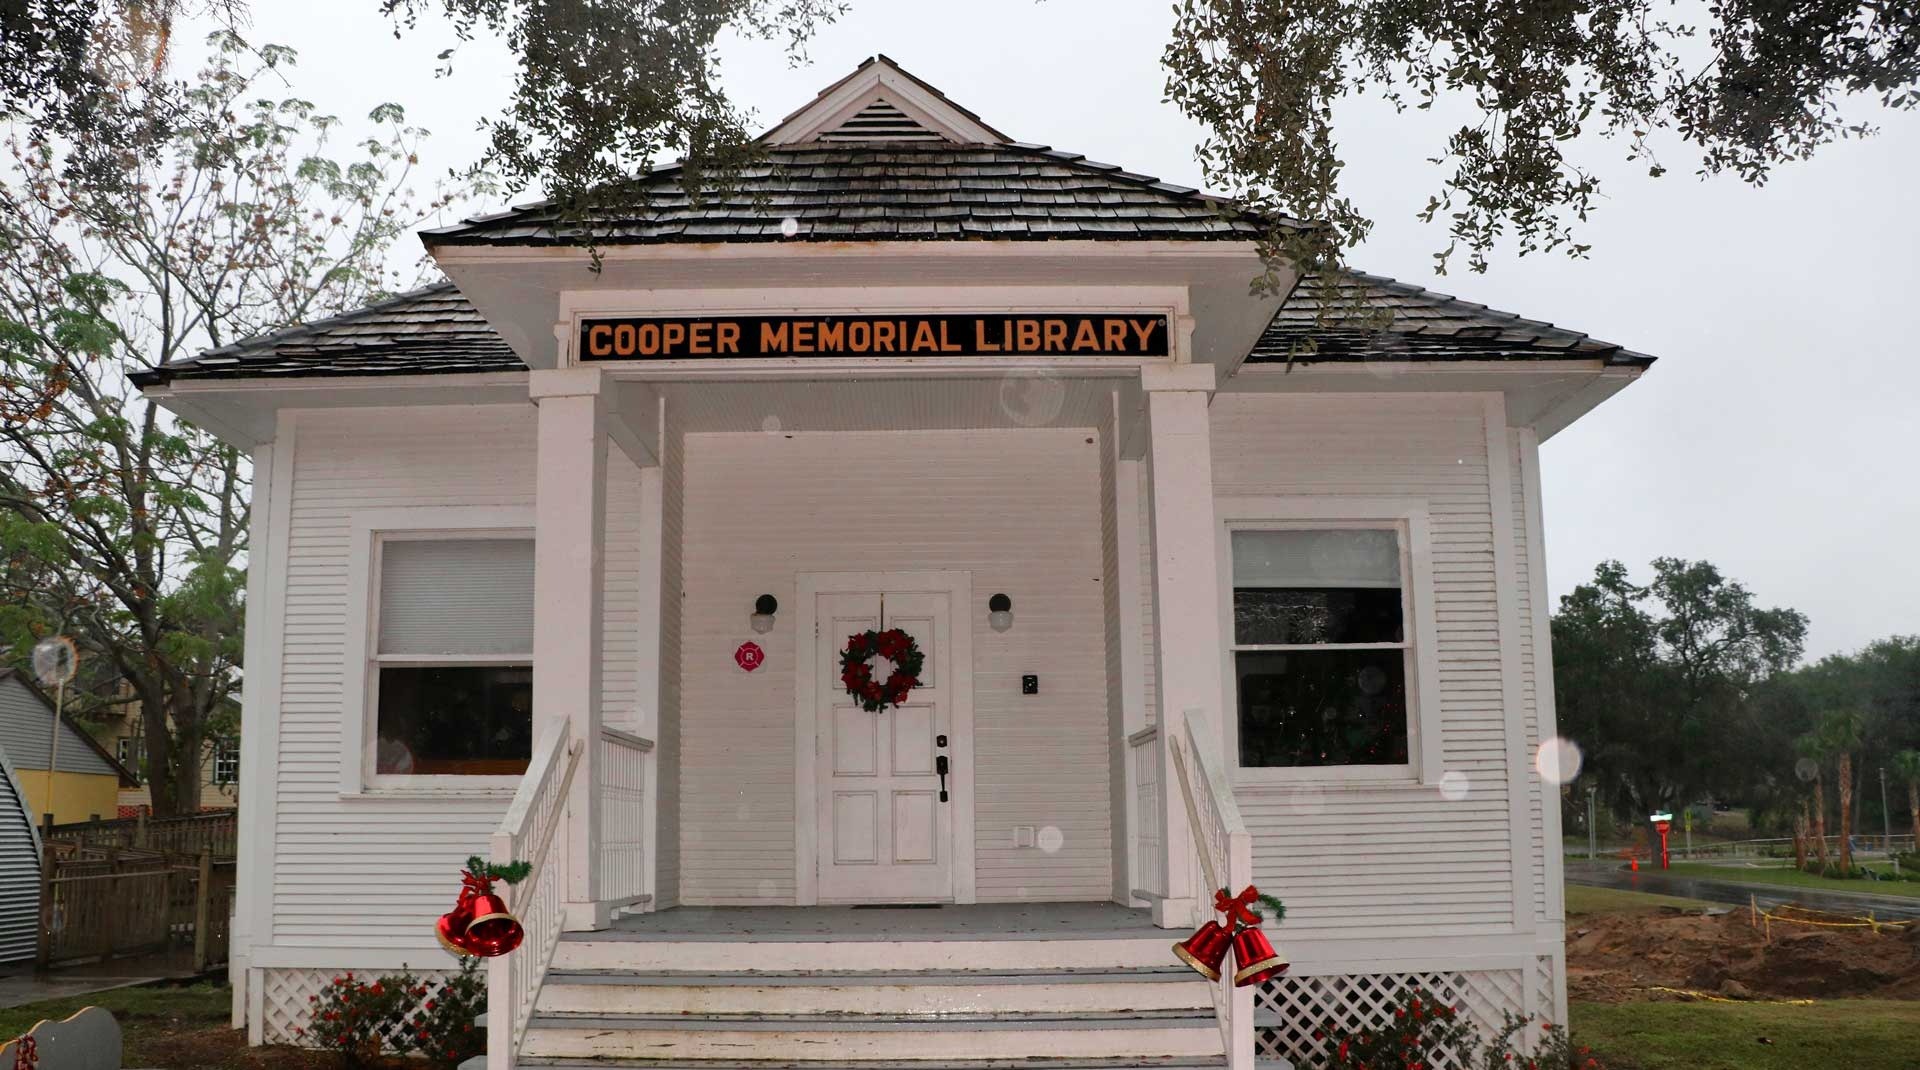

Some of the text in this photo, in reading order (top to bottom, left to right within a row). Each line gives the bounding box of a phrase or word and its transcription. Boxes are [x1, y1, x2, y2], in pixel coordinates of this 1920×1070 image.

[589, 319, 1157, 356] COOPER MEMORIAL LIBRARY
[745, 652, 754, 661] R
